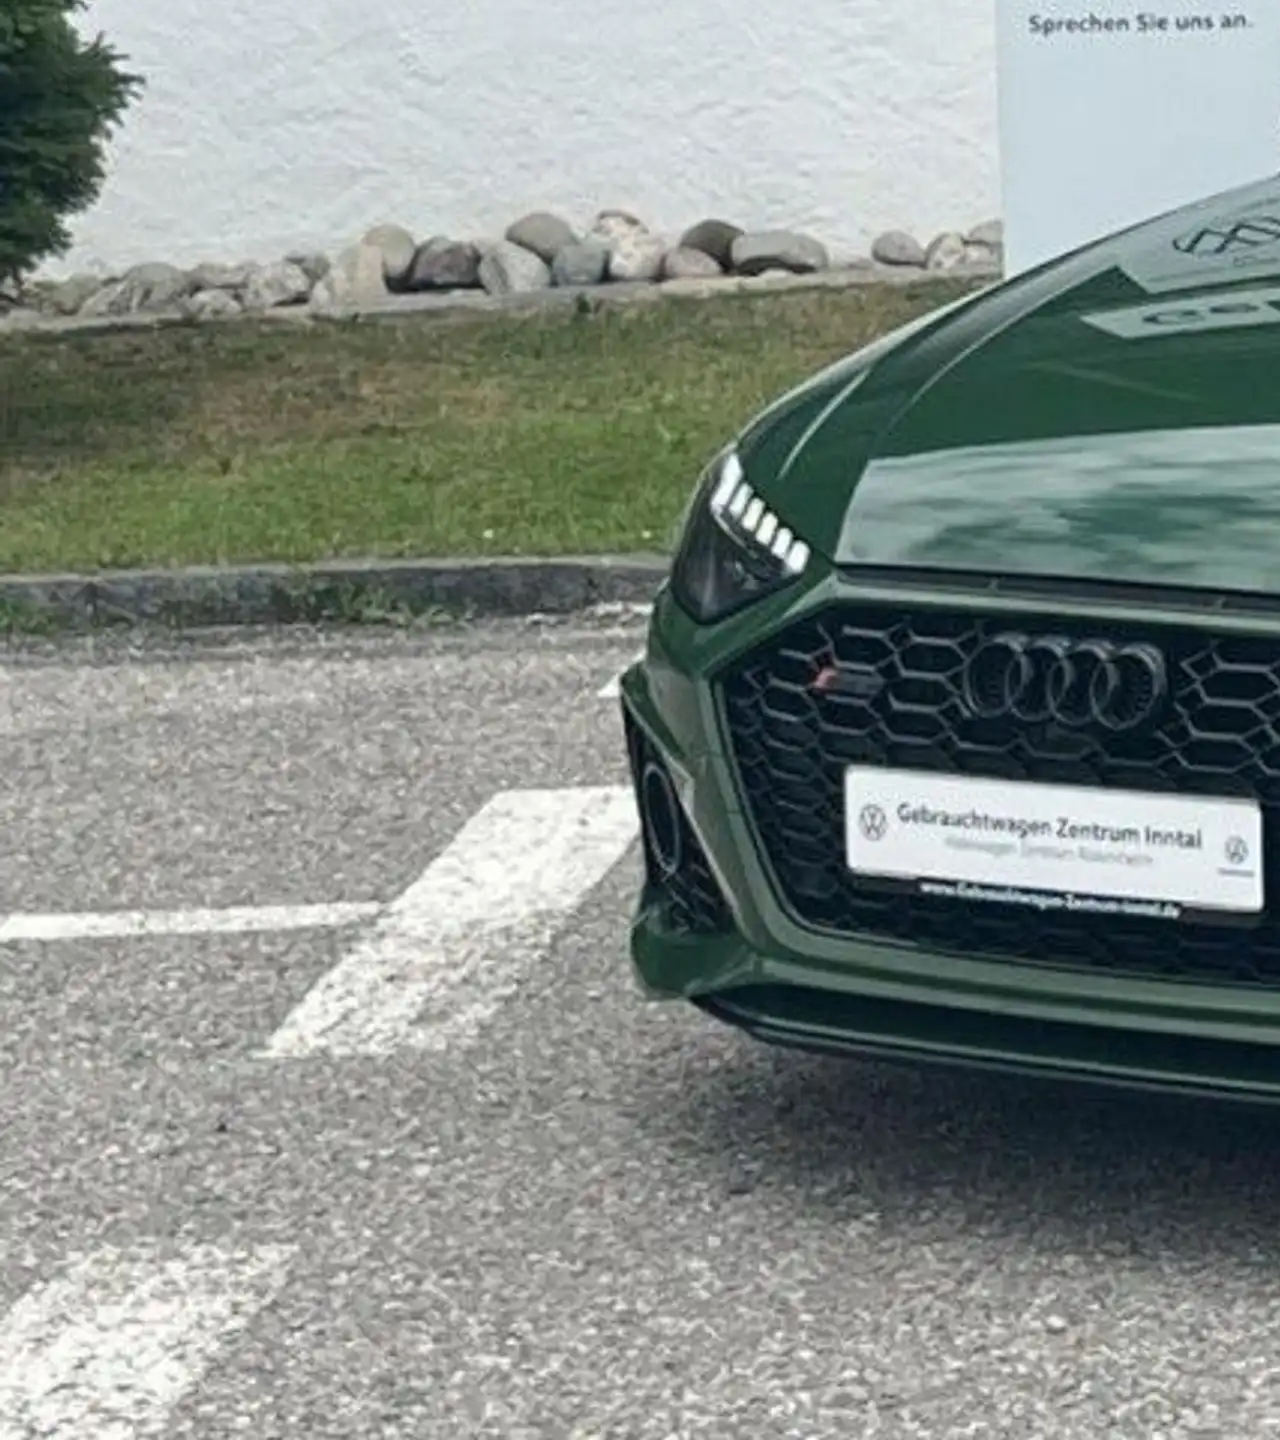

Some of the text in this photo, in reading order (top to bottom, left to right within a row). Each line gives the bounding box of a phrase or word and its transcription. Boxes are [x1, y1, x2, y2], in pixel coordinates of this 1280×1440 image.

[1027, 12, 1253, 39] Sprechen Sie uns an.
[896, 801, 1051, 839] Gebrauchtwagen
[1055, 816, 1141, 843] Zentrum
[1144, 824, 1203, 850] Inntal
